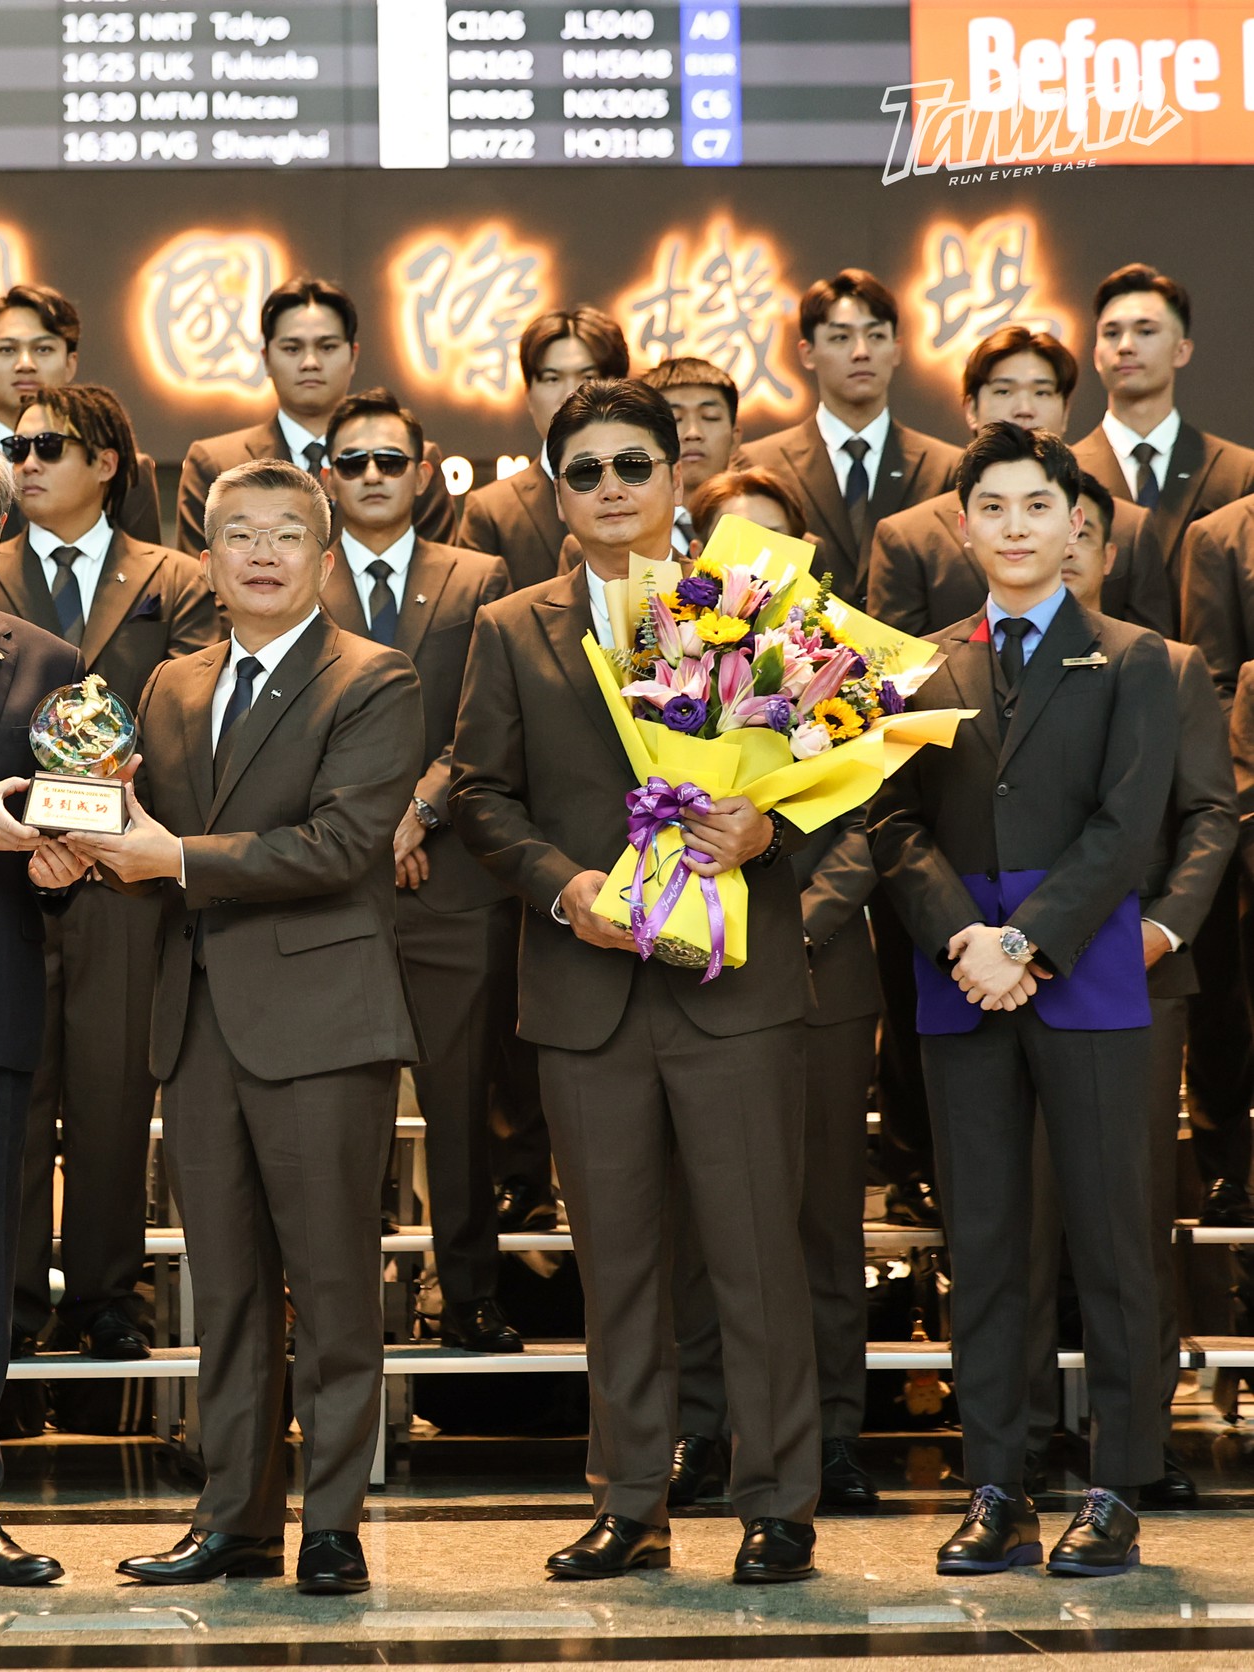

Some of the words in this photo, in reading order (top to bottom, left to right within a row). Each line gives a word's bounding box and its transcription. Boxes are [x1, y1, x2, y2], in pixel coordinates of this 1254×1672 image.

[62, 12, 135, 43] 16:25
[139, 12, 197, 41] NRT
[209, 11, 290, 47] Tokyo
[62, 52, 135, 82] 16:25
[140, 51, 194, 81] FUK
[211, 50, 319, 80] Fukuoka
[968, 16, 1220, 132] Before
[63, 91, 136, 122] 16:30
[140, 90, 208, 120] MFM
[212, 90, 298, 120] Macau
[63, 131, 137, 162] 16:30
[140, 130, 198, 160] PVG
[212, 129, 329, 165] Shanghai
[692, 128, 732, 159] C7
[42, 796, 108, 814] 馬到成功
